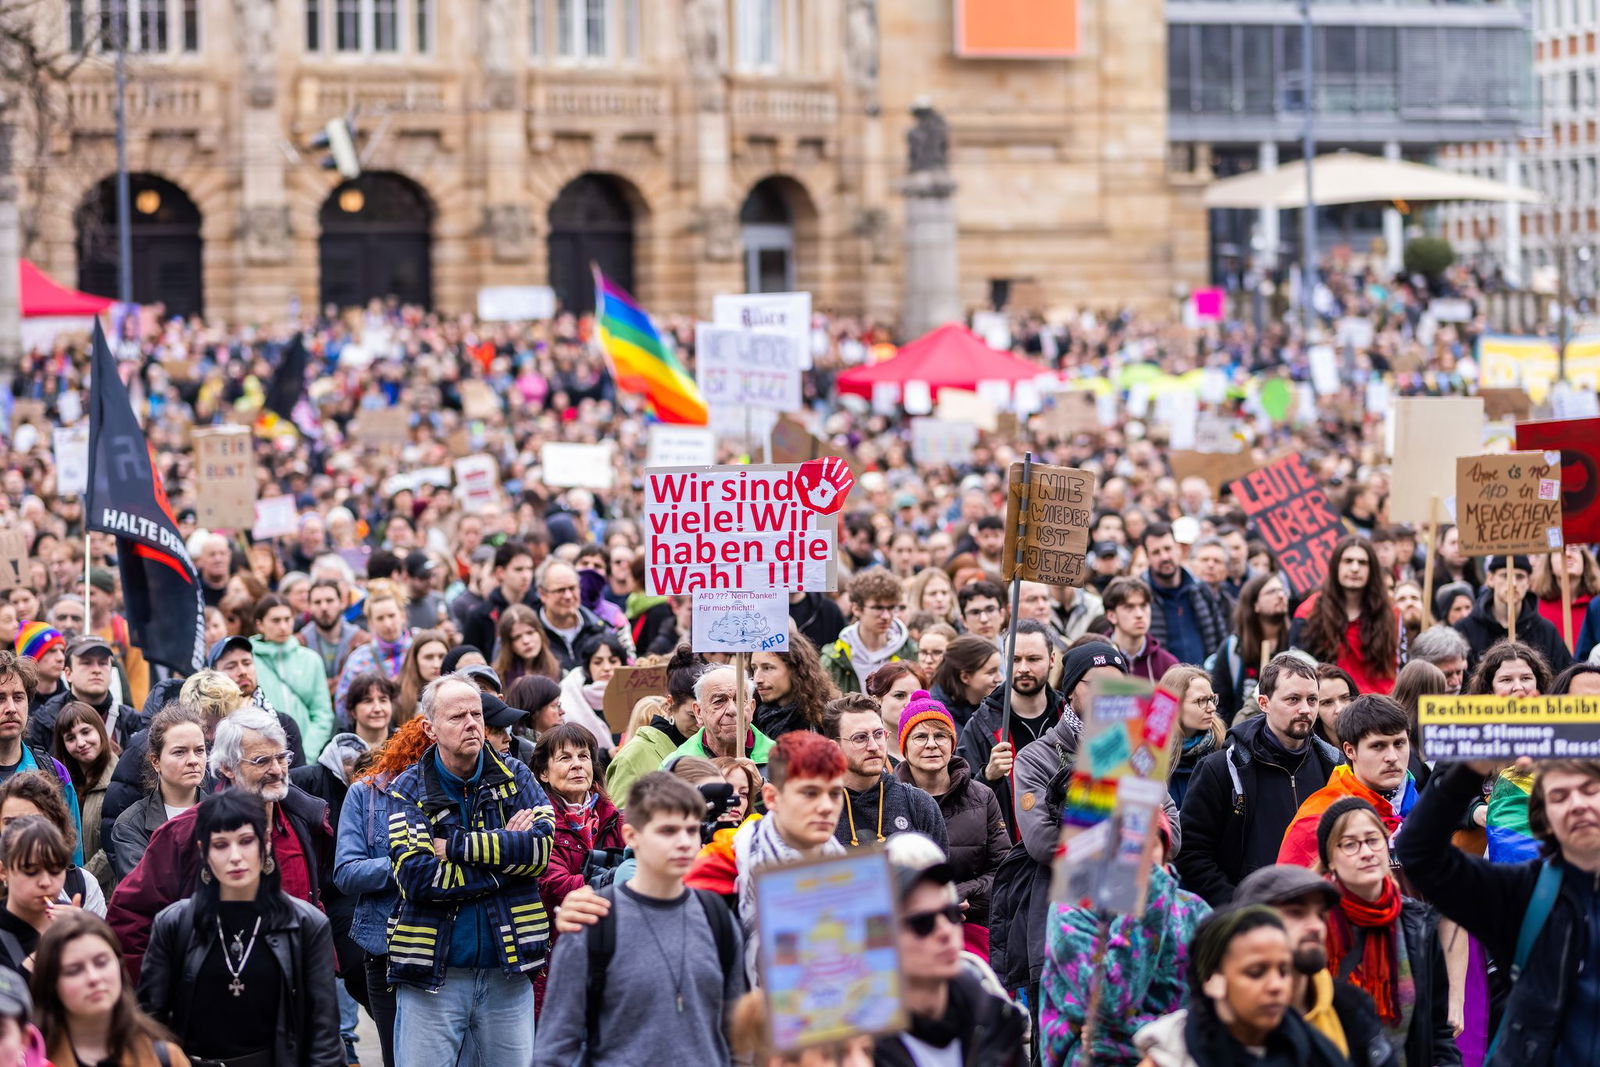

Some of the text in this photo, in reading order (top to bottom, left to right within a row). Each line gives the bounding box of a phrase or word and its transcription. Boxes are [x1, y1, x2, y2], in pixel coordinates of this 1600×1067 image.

[650, 471, 793, 503] Wir sind
[1039, 474, 1085, 503] NIE
[1229, 453, 1316, 515] LEUTE
[103, 508, 159, 541] HALTE
[649, 501, 815, 534] viele! Wir
[1031, 502, 1090, 528] WIEDER
[652, 531, 828, 565] haben die
[1036, 525, 1070, 546] IST
[1027, 545, 1086, 576] JETZT
[650, 561, 804, 596] Wahl !!!
[699, 592, 777, 600] AFD ??? Nein Danke!!
[699, 604, 711, 612] Für
[712, 604, 730, 612] mich
[761, 633, 785, 651] AFD
[1426, 698, 1598, 716] Rechtsaußen bleibt
[1424, 724, 1555, 741] Keine Stimme
[1424, 739, 1455, 756] für
[1457, 739, 1511, 755] Nazis
[1513, 738, 1551, 755] und
